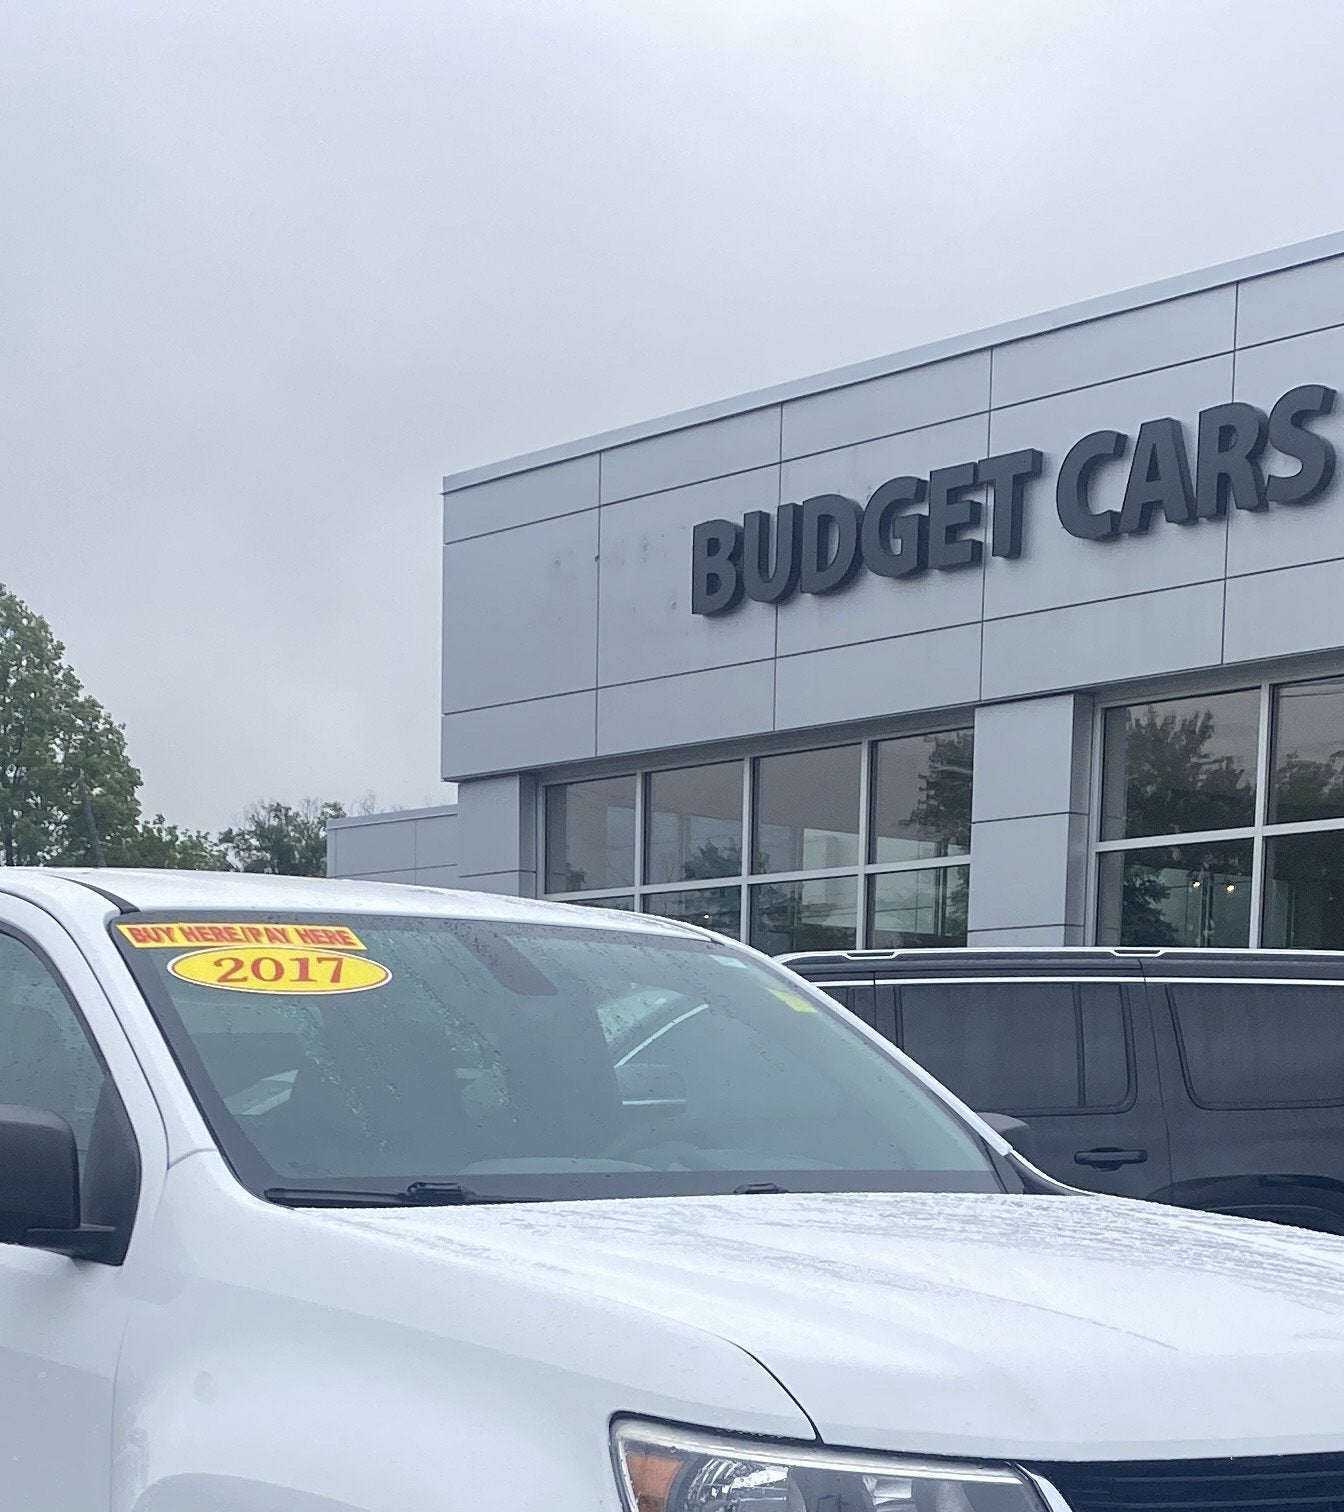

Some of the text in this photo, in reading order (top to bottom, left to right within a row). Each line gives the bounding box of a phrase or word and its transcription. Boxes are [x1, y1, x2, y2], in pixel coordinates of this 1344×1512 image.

[692, 383, 1337, 616] BUDGET CARS
[126, 926, 175, 943] BUY
[296, 927, 357, 946] HERE
[213, 956, 344, 983] 2017
